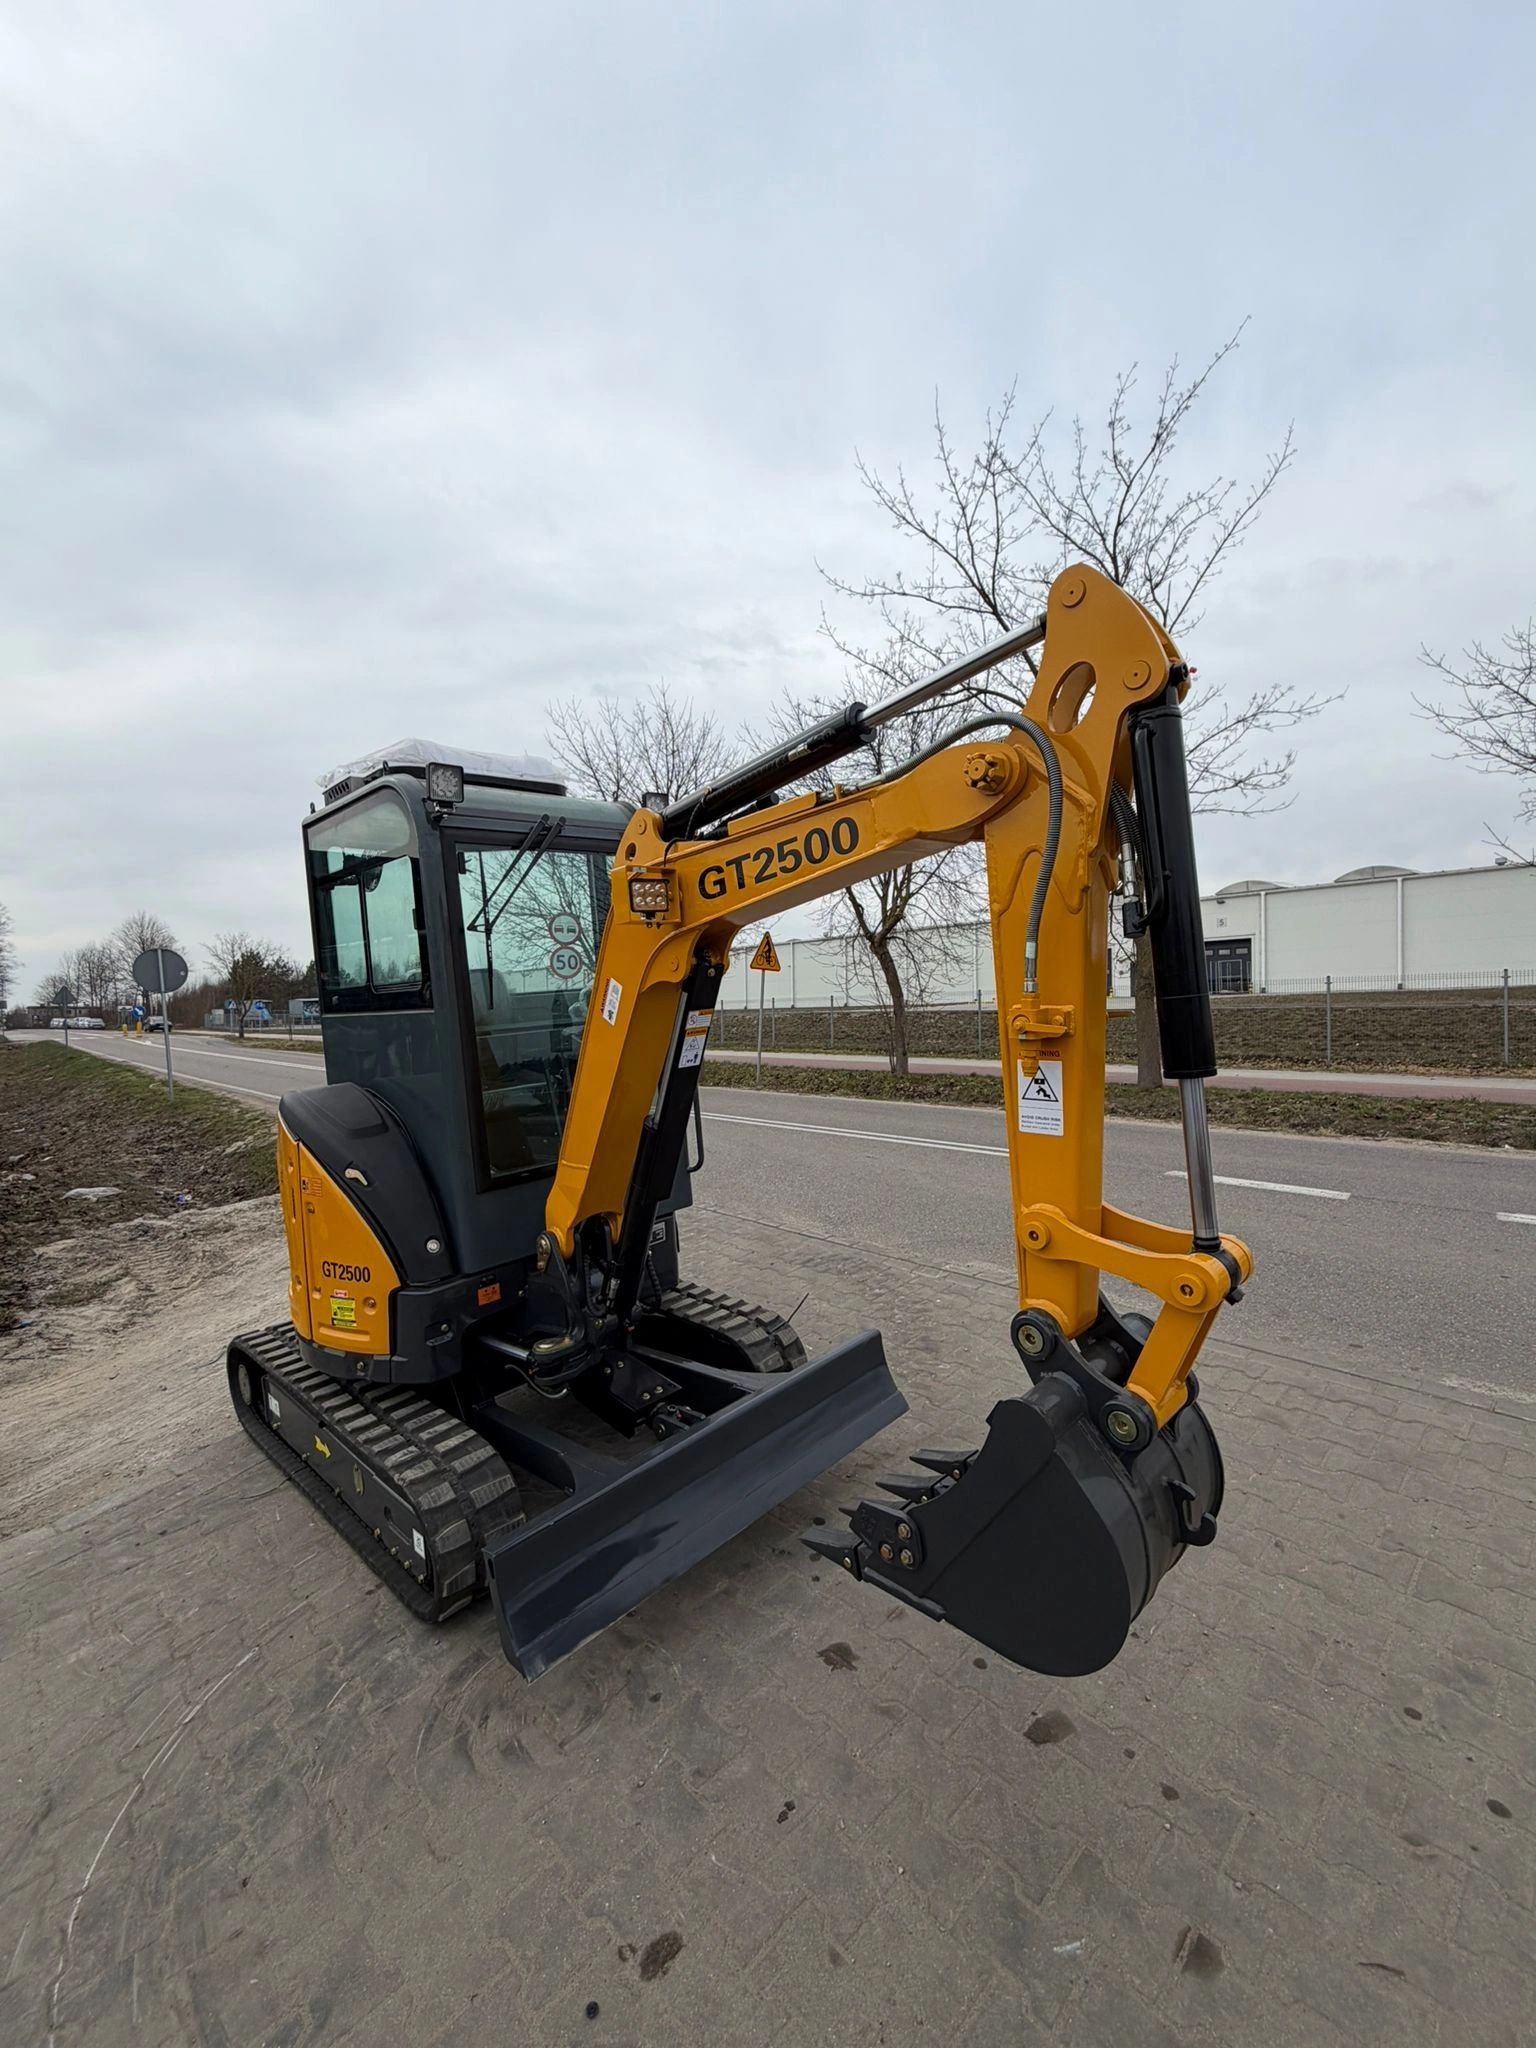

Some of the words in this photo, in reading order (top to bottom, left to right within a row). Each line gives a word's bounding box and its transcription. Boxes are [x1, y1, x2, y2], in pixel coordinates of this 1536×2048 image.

[698, 817, 860, 900] GT2500
[556, 954, 578, 970] 50
[322, 1260, 371, 1283] GT2500
